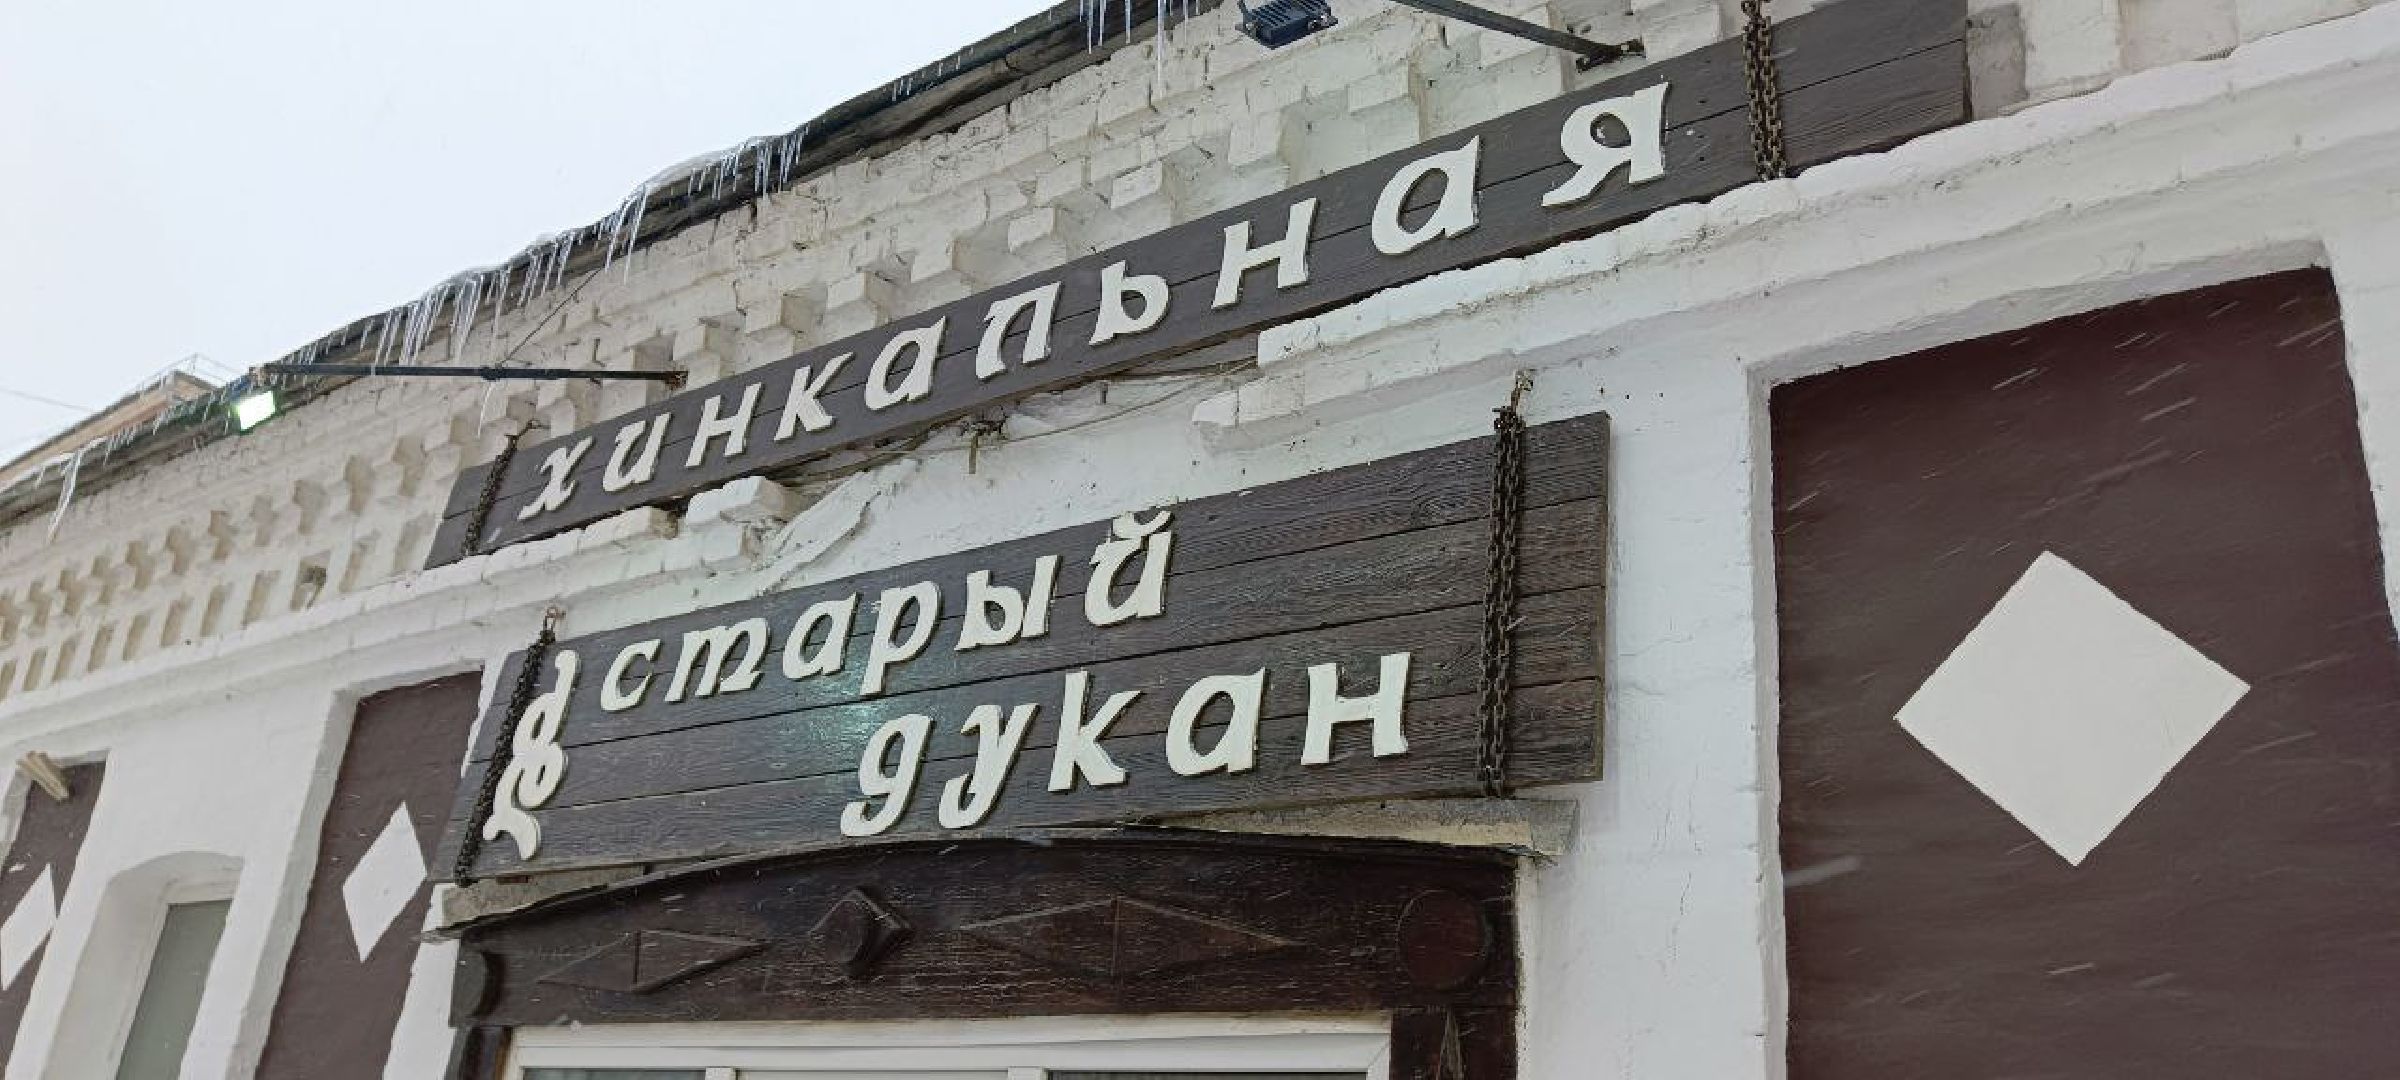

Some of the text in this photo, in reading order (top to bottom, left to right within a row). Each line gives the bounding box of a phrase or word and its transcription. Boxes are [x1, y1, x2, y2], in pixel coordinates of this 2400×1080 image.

[518, 81, 1670, 521] хинкальная
[599, 508, 1175, 712] старый
[839, 651, 1411, 838] дукан
